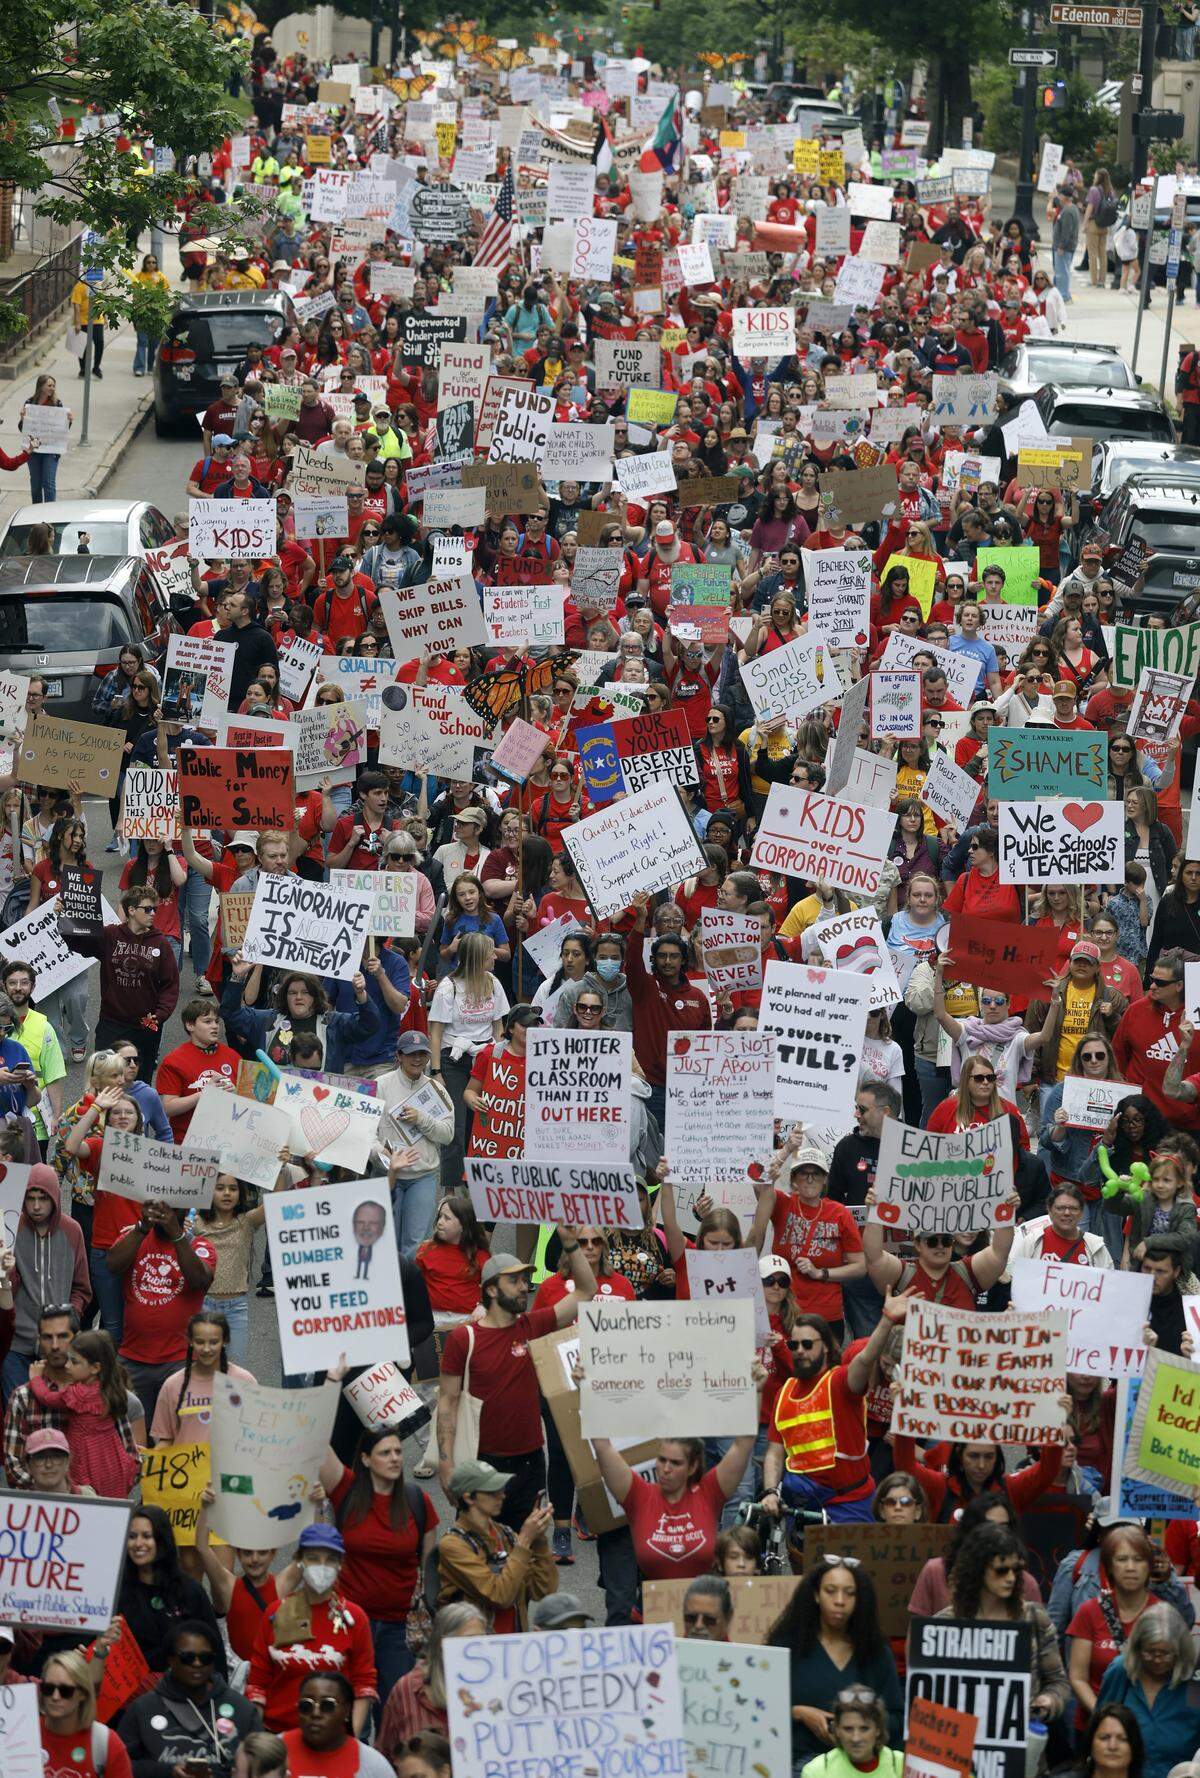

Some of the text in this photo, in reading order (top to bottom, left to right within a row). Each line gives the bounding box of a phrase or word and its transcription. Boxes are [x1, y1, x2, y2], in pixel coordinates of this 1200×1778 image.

[1062, 8, 1109, 23] Edenton
[319, 173, 349, 186] WTF
[459, 182, 499, 194] INVEST
[341, 255, 357, 263] NOT
[405, 317, 460, 329] Overworked
[746, 312, 789, 331] KIDS
[406, 330, 454, 342] Underpaid
[737, 339, 789, 349] Corporations
[443, 354, 483, 369] Fund
[613, 349, 642, 361] FUND
[616, 361, 640, 372] OUR
[608, 371, 651, 383] FUTURE
[443, 383, 481, 398] Fund
[502, 390, 551, 414] FUND
[494, 410, 547, 445] Public
[553, 430, 594, 441] WHAT IS
[550, 458, 585, 466] TO YOU?
[194, 501, 263, 513] All we are
[213, 528, 263, 550] KIDS
[1129, 547, 1145, 557] FULLY
[435, 557, 463, 566] KIDS
[500, 562, 544, 575] FUND
[817, 560, 855, 573] TEACHERS
[1113, 561, 1141, 578] SCHOOLS
[1121, 558, 1140, 570] PUBLIC
[396, 580, 462, 602] WE CAN'T
[484, 587, 498, 596] How
[524, 587, 537, 599] put
[485, 613, 506, 623] When
[520, 611, 533, 625] put
[401, 617, 463, 639] WHY CAN
[425, 637, 455, 654] YOU?
[338, 658, 396, 673] QUALITY
[208, 672, 225, 685] PAY
[880, 674, 916, 683] THE FUTURE
[412, 688, 446, 710] Fund
[577, 686, 600, 697] ELMO
[428, 710, 453, 720] our
[889, 714, 897, 722] IN
[897, 714, 914, 723] OUR
[632, 714, 664, 735] OUR
[876, 722, 914, 732] CLASSROOMS
[32, 723, 121, 752] IMAGINE SCHOOLS
[626, 729, 681, 752] YOUTH
[45, 747, 94, 763] AS FUNDED
[621, 747, 694, 776] DESERVE
[1010, 749, 1089, 777] SHAME
[43, 764, 86, 779] AS ICE
[181, 752, 289, 785] Public Money
[225, 780, 248, 791] for
[126, 793, 162, 806] LET US
[126, 806, 175, 819] THIS LOW
[800, 795, 866, 843] KIDS
[1008, 805, 1056, 834] We
[612, 823, 637, 840] Is A
[811, 840, 843, 856] over
[1003, 833, 1118, 861] Public Schools
[754, 840, 880, 893] CORPORATIONS
[67, 873, 81, 882] WE
[333, 873, 413, 893] TEACHERS
[68, 883, 93, 894] FULLY
[64, 892, 97, 903] FUNDED
[65, 901, 96, 912] PUBLIC
[262, 880, 370, 932] IGNORANCE
[60, 910, 103, 921] SCHOOLS
[703, 915, 760, 930] CUTS TO
[817, 915, 879, 944] PROTECT
[703, 933, 760, 949] EDUCATION
[262, 934, 350, 976] STRATEGY!
[707, 966, 759, 983] NEVER
[533, 1037, 621, 1056] IT'S HOTTER
[551, 1056, 598, 1071] IN MY
[674, 1057, 774, 1074] JUST ABOUT
[777, 1044, 856, 1072] TILL?
[492, 1062, 518, 1090] We
[528, 1071, 622, 1089] CLASSROOM
[776, 1075, 828, 1091] Embarrassing
[536, 1091, 609, 1103] THAN IT IS
[541, 1107, 627, 1123] OUT HERE.
[148, 1148, 219, 1165] collected from the
[888, 1170, 1004, 1202] FUND PUBLIC
[281, 1201, 331, 1220] NC IS
[485, 1188, 631, 1225] DESERVE BETTER
[907, 1203, 991, 1232] SCHOOLS
[279, 1224, 339, 1244] GETTING
[282, 1247, 344, 1266] DUMBER
[772, 1258, 782, 1266] H
[142, 1272, 172, 1286] Public
[286, 1273, 330, 1290] WHILE
[1042, 1265, 1104, 1302] Fund
[140, 1282, 172, 1295] Schools
[291, 1290, 368, 1311] YOU FEED
[292, 1307, 405, 1337] CORPORATIONS
[586, 1311, 736, 1333] Vouchers: robbing
[900, 1388, 927, 1408] WE
[935, 1393, 1008, 1418] BORROW
[1011, 1401, 1036, 1418] IT
[922, 1625, 1018, 1662] STRAIGHT
[507, 1671, 644, 1718] GREEDY
[473, 1714, 619, 1761] PUT KIDS
